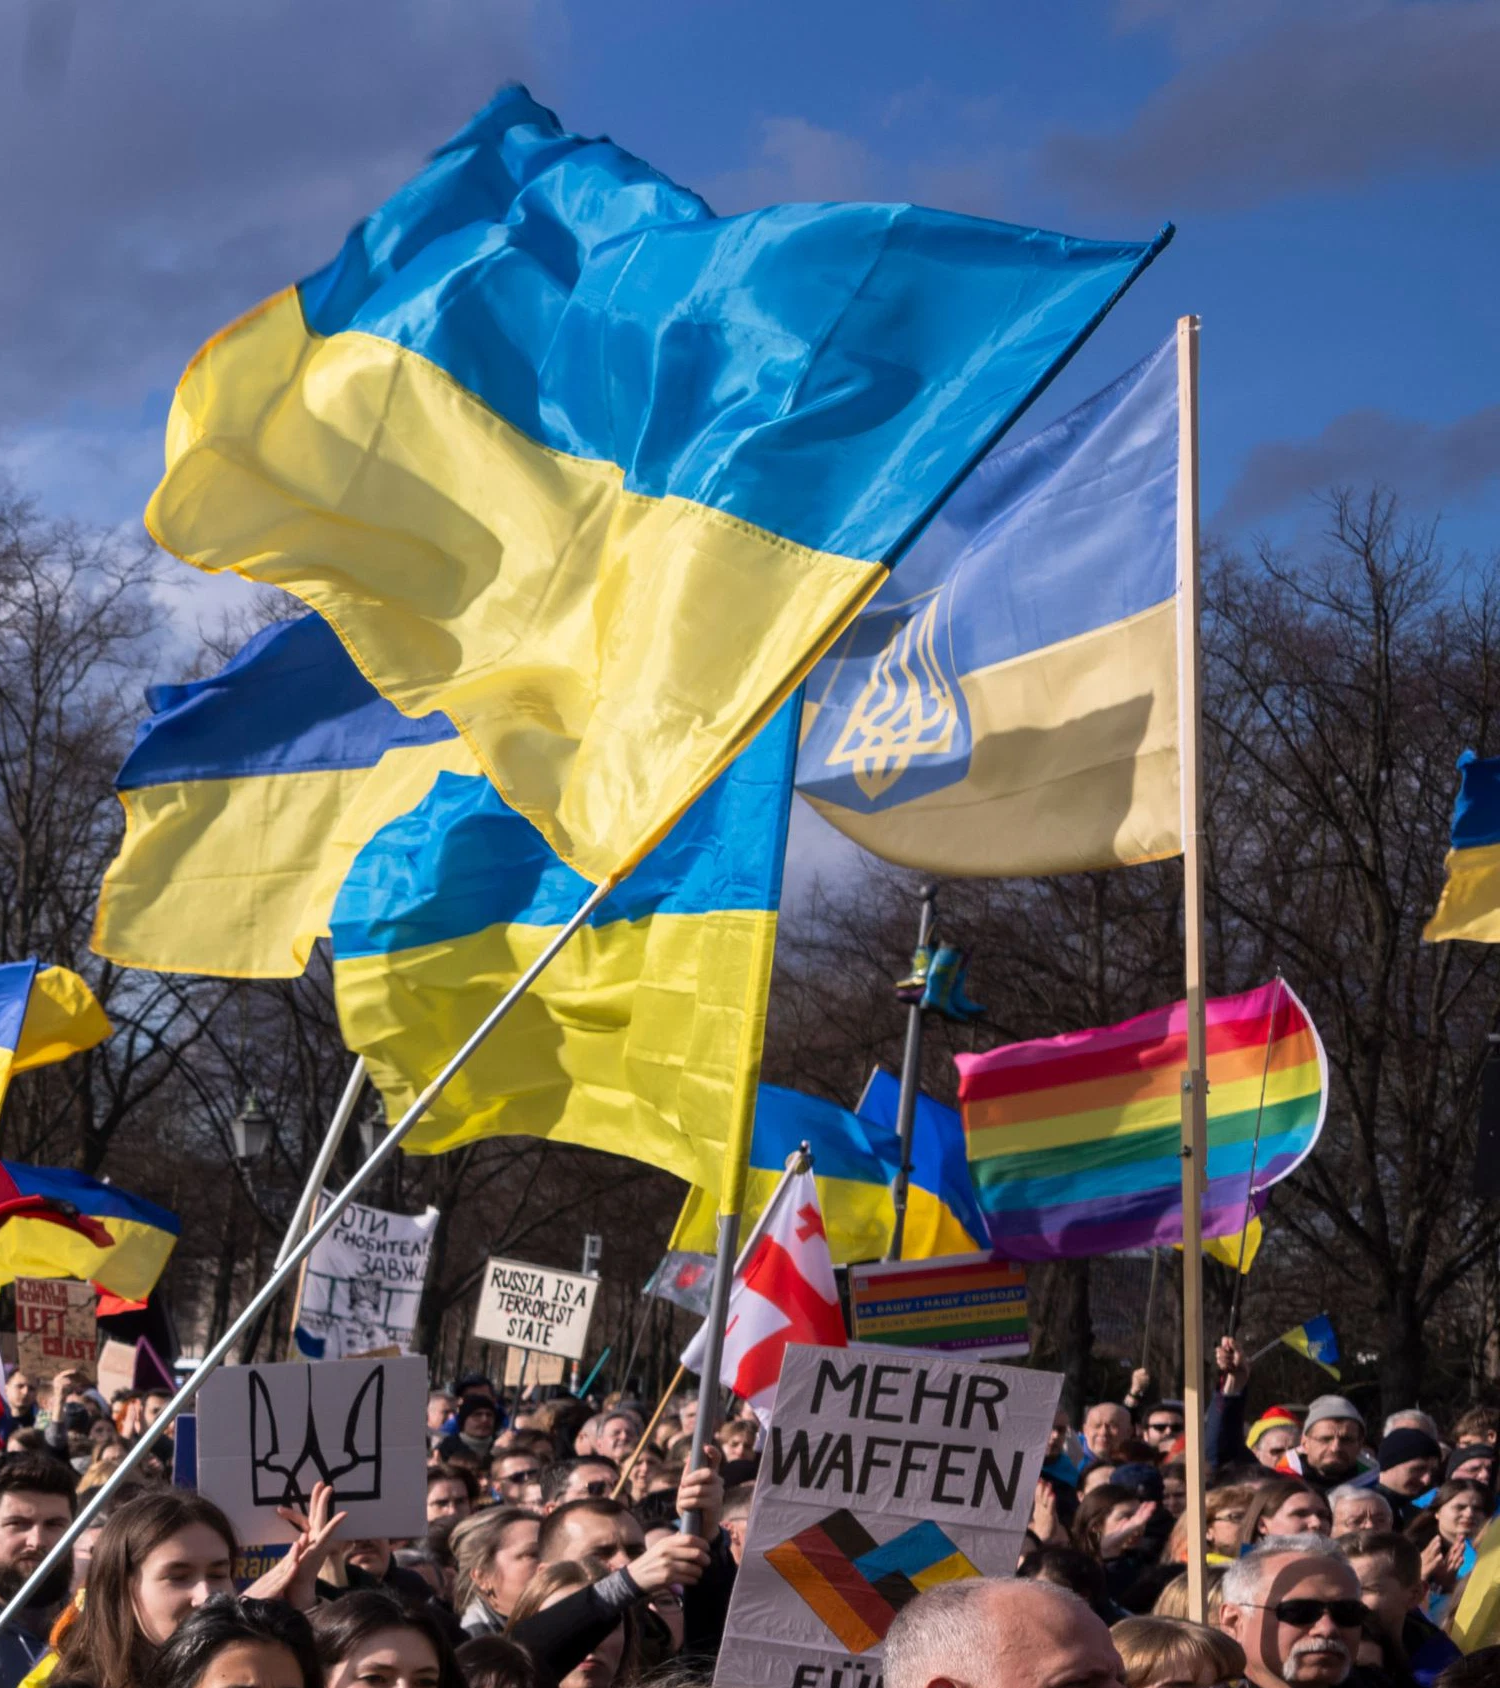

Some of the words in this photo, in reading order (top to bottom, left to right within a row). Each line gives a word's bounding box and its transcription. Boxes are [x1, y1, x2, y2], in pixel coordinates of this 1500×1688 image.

[490, 1267, 545, 1298] RUSSIA
[552, 1278, 574, 1303] IS
[574, 1286, 587, 1308] A
[876, 1300, 912, 1313] ВАШУ
[923, 1295, 961, 1309] НАШУ
[963, 1287, 1025, 1305] СВОБОДУ
[16, 1304, 67, 1337] LEFT
[497, 1291, 575, 1327] TERRORIST
[506, 1318, 555, 1347] STATE
[809, 1359, 1011, 1433] MEHR
[768, 1425, 1025, 1512] WAFFEN
